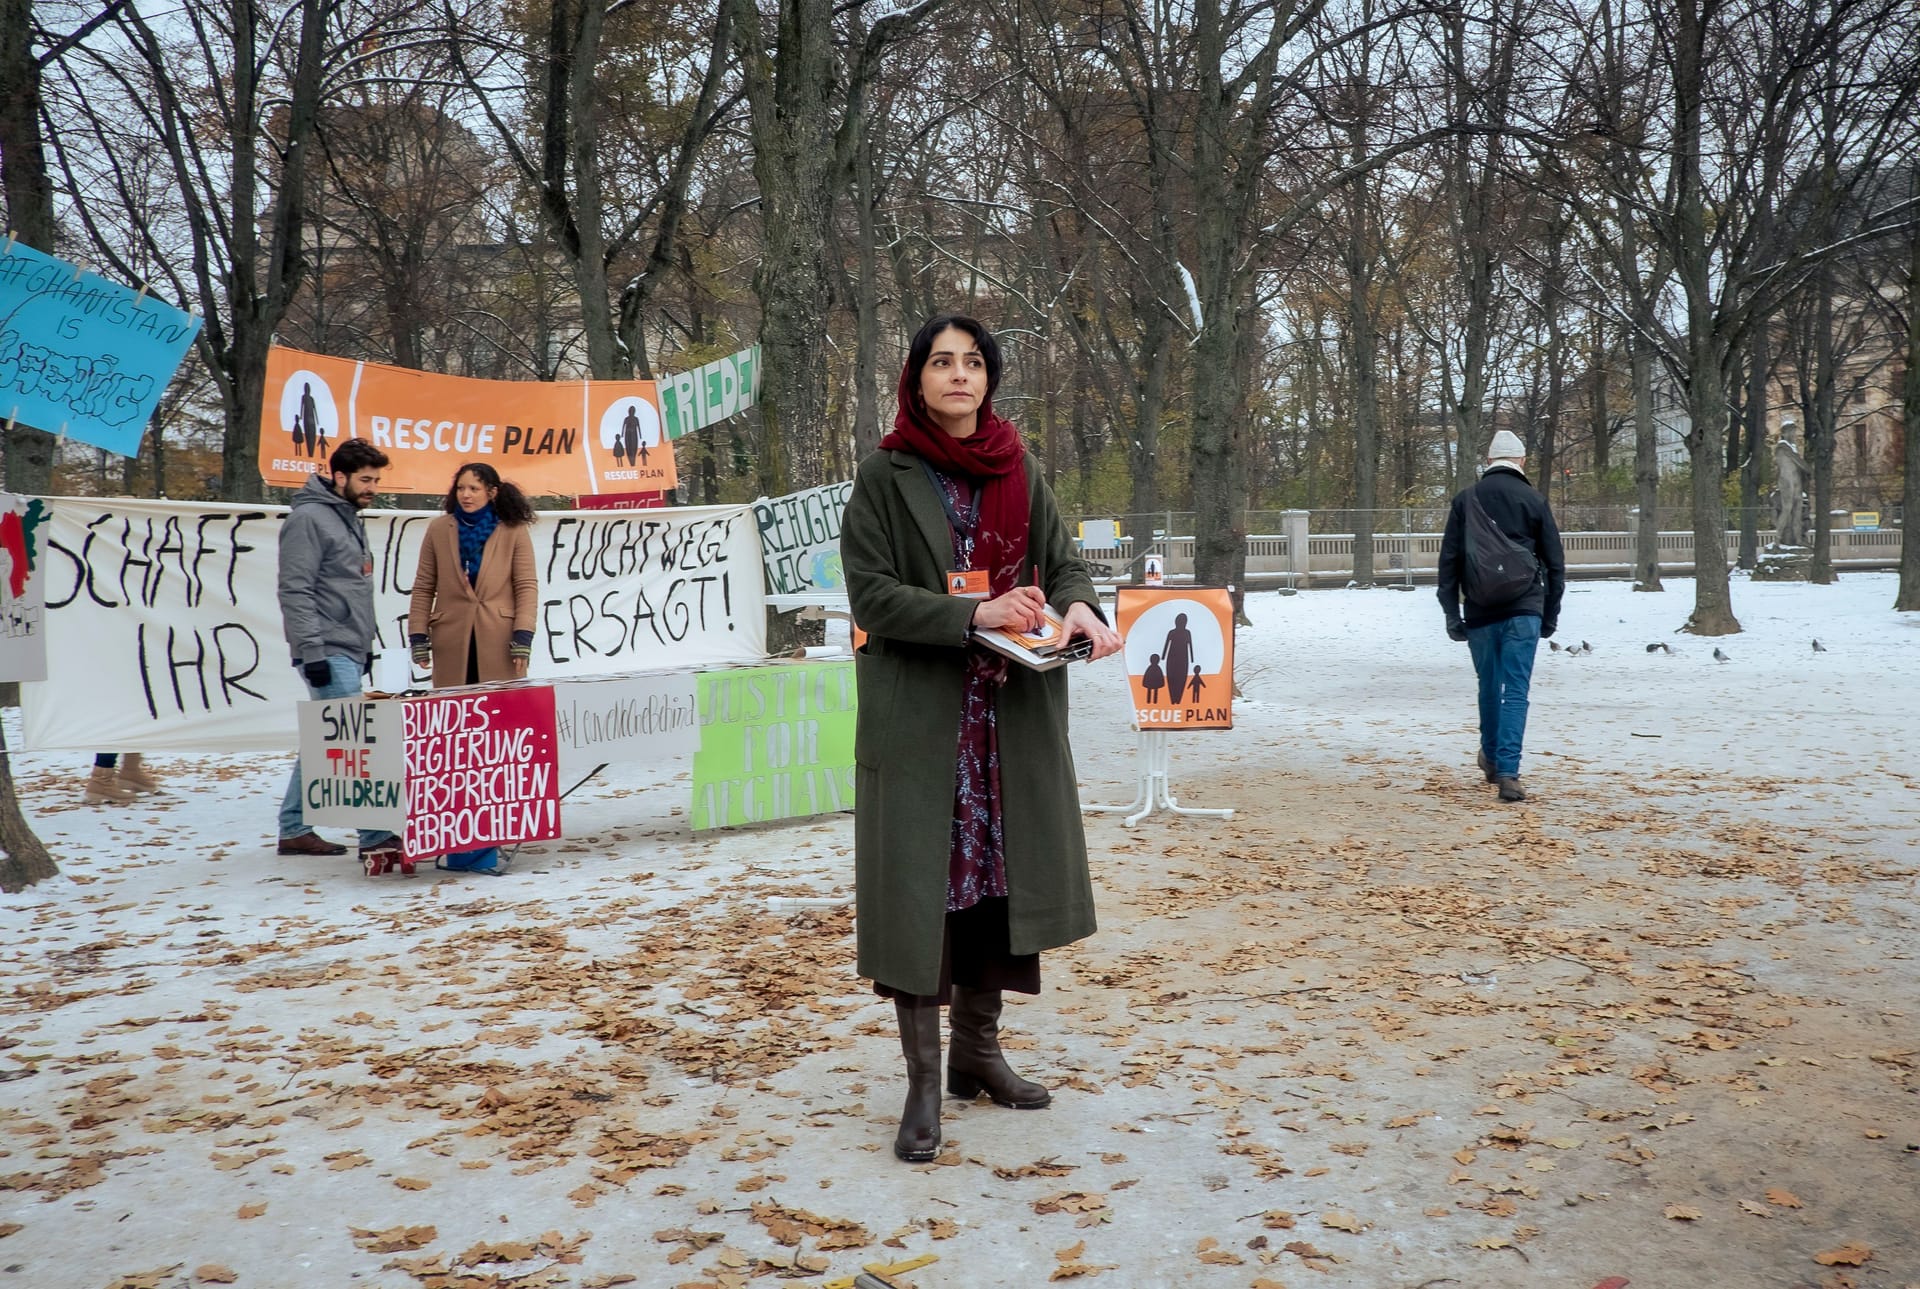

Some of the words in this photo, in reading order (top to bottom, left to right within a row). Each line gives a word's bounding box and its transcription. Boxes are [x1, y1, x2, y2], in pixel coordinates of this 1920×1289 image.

[56, 315, 84, 340] IS
[371, 415, 496, 455] RESCUE
[502, 425, 576, 455] PLAN
[272, 458, 316, 474] RESCUE
[604, 470, 639, 480] RESCUE
[640, 469, 664, 479] PLAN
[543, 570, 735, 664] ERSAGT!
[137, 622, 269, 720] IHR
[699, 667, 857, 726] JUSTICE
[1135, 708, 1182, 723] SCUE
[1185, 708, 1228, 722] PLAN
[321, 702, 377, 744] SAVE
[401, 695, 501, 741] BUNDES-
[326, 748, 371, 779] THE
[743, 719, 820, 772] FOR
[307, 777, 401, 810] CHILDREN
[404, 762, 552, 816] VERSPRECHEN
[403, 799, 556, 858] GEBROCHEN!
